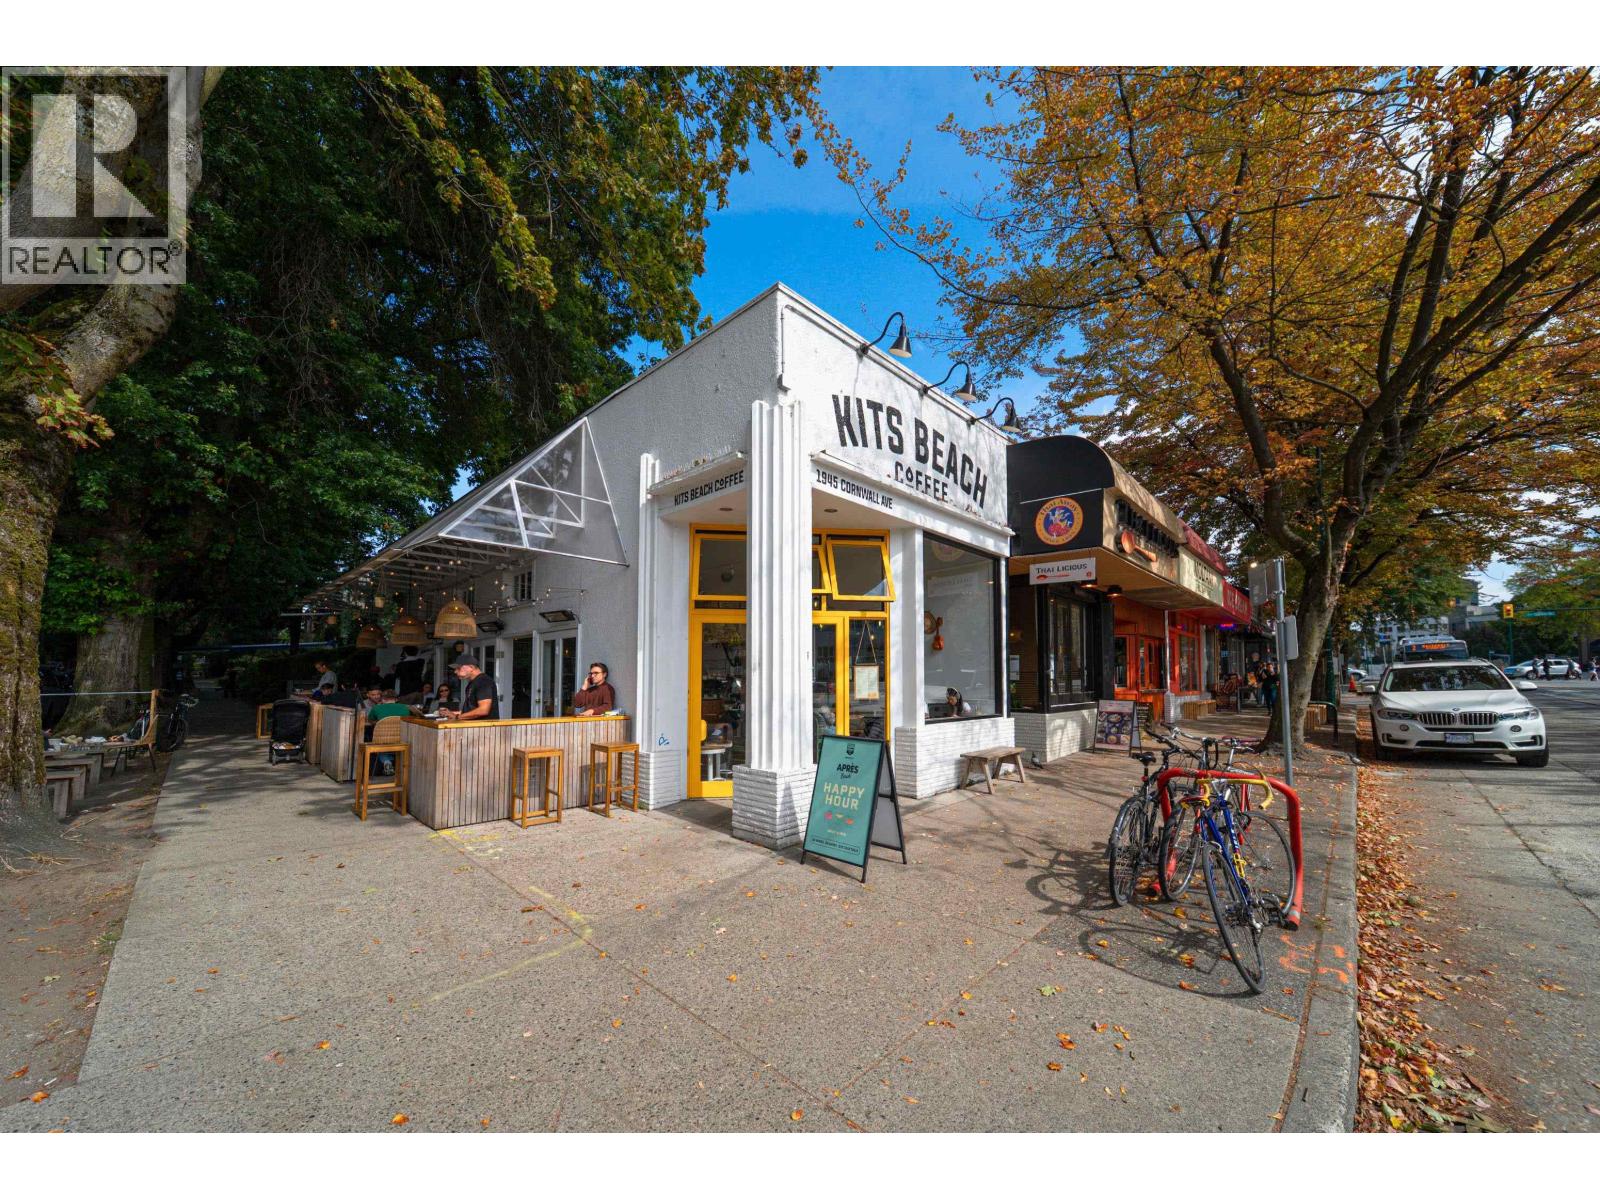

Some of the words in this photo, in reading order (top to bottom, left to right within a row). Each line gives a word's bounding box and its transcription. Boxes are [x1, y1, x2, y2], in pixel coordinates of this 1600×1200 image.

[831, 394, 904, 455] KITS
[914, 417, 988, 509] BEACH
[674, 490, 689, 506] KITS
[690, 481, 713, 501] BEACH
[714, 470, 744, 492] COFFEE
[816, 468, 838, 489] 1945
[840, 478, 880, 505] CORNWALL
[880, 495, 893, 510] AVE
[894, 461, 949, 503] COFFEE
[823, 782, 865, 799] HAPPY
[824, 793, 859, 811] HOUR
